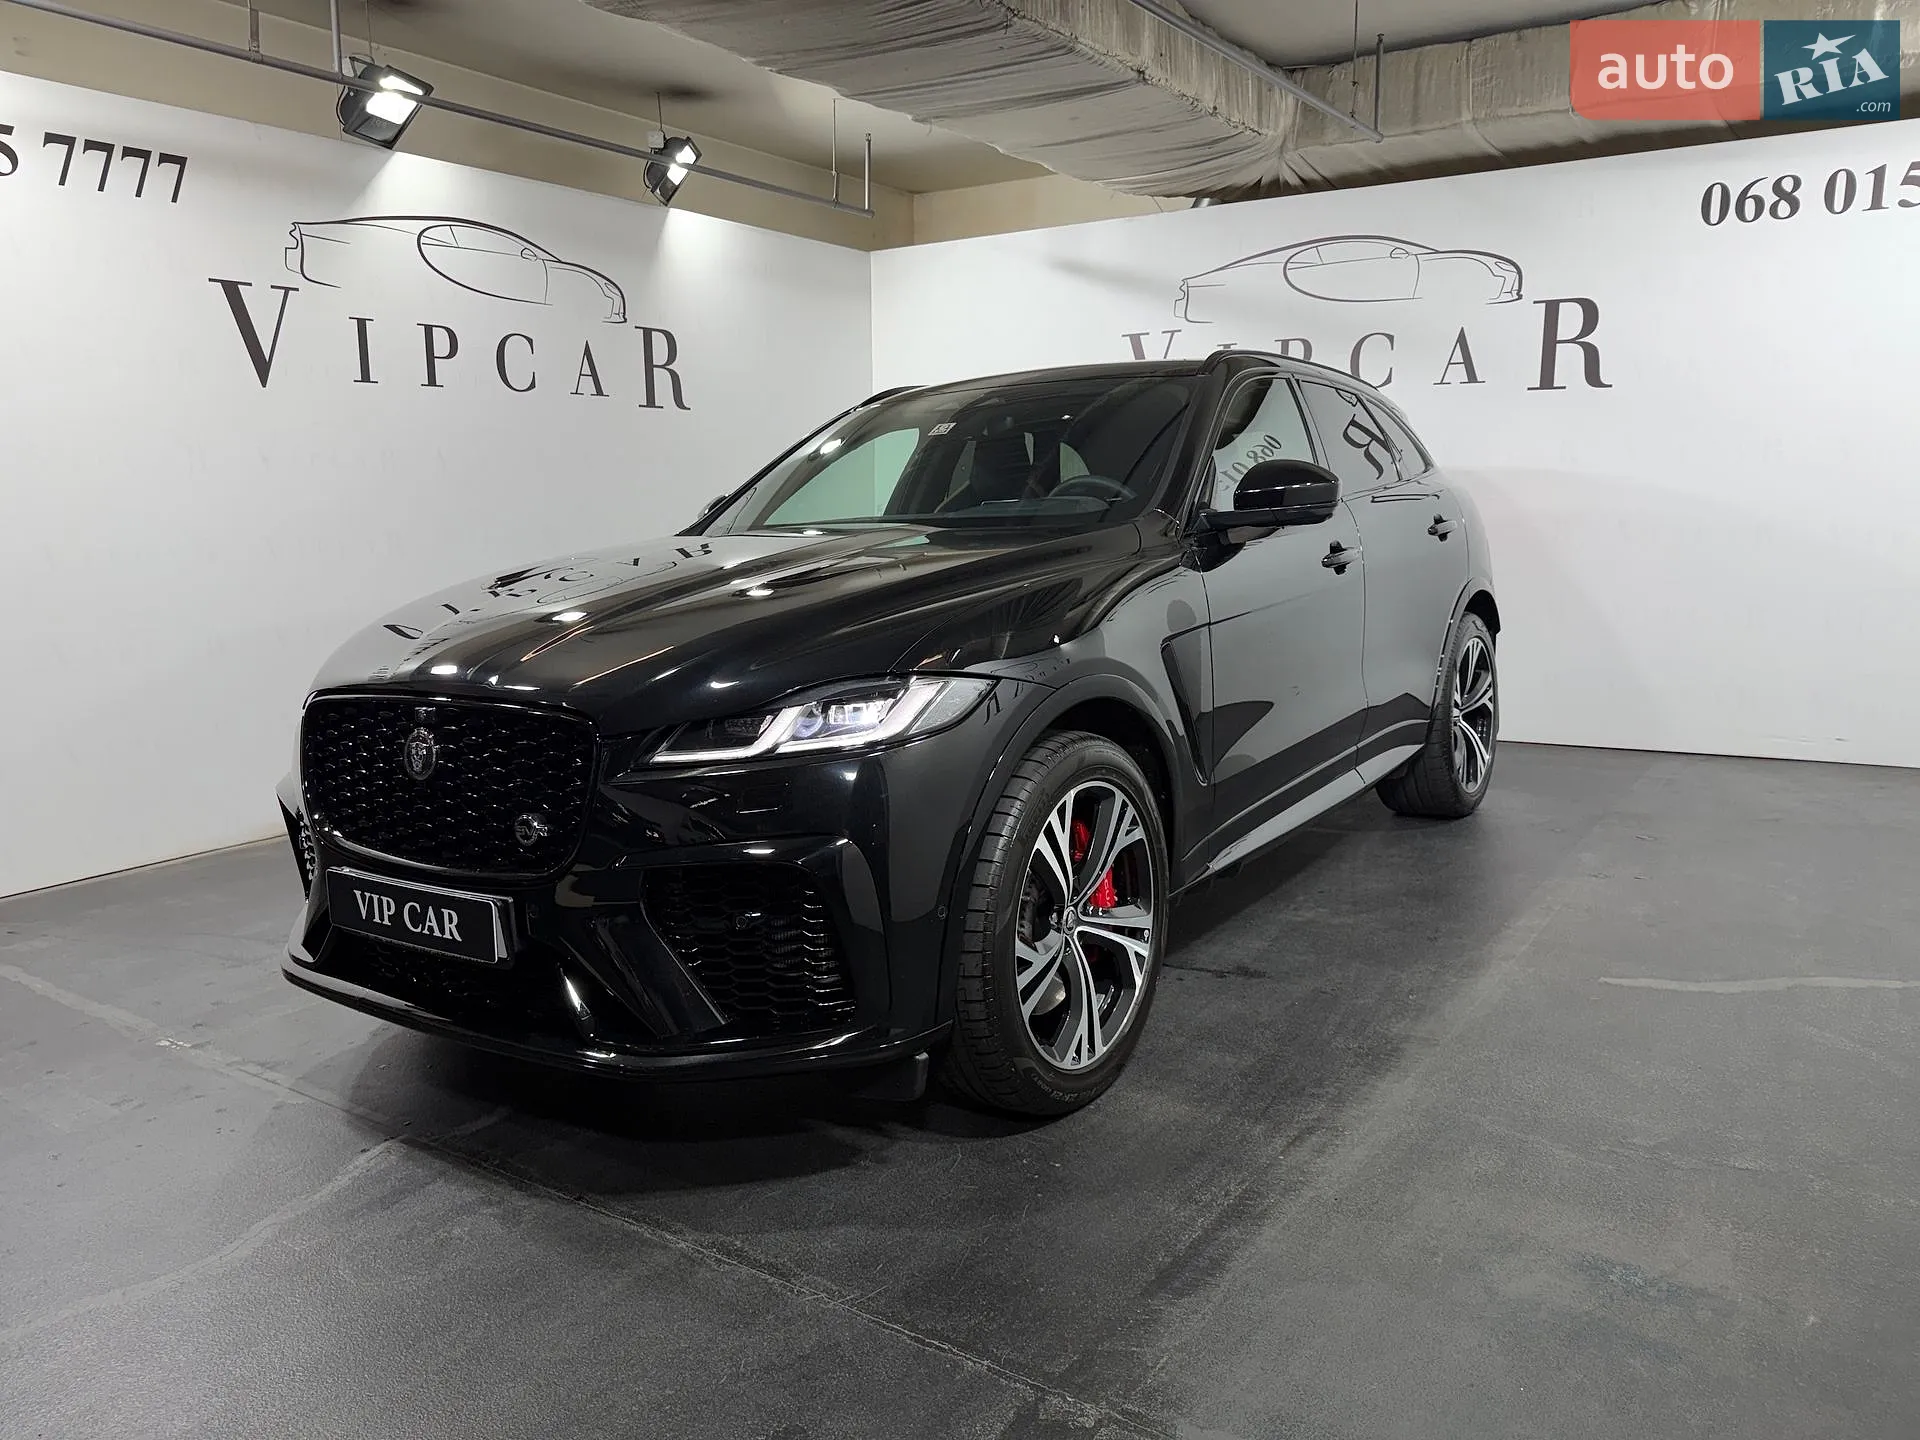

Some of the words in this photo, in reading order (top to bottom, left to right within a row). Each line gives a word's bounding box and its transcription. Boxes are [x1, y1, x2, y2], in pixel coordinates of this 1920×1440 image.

[43, 132, 188, 203] 7777
[1701, 174, 1802, 226] 068
[208, 278, 691, 411] VIPCAR
[1121, 297, 1613, 391] PCAR
[353, 889, 396, 926] VIP
[403, 902, 463, 942] CAR
